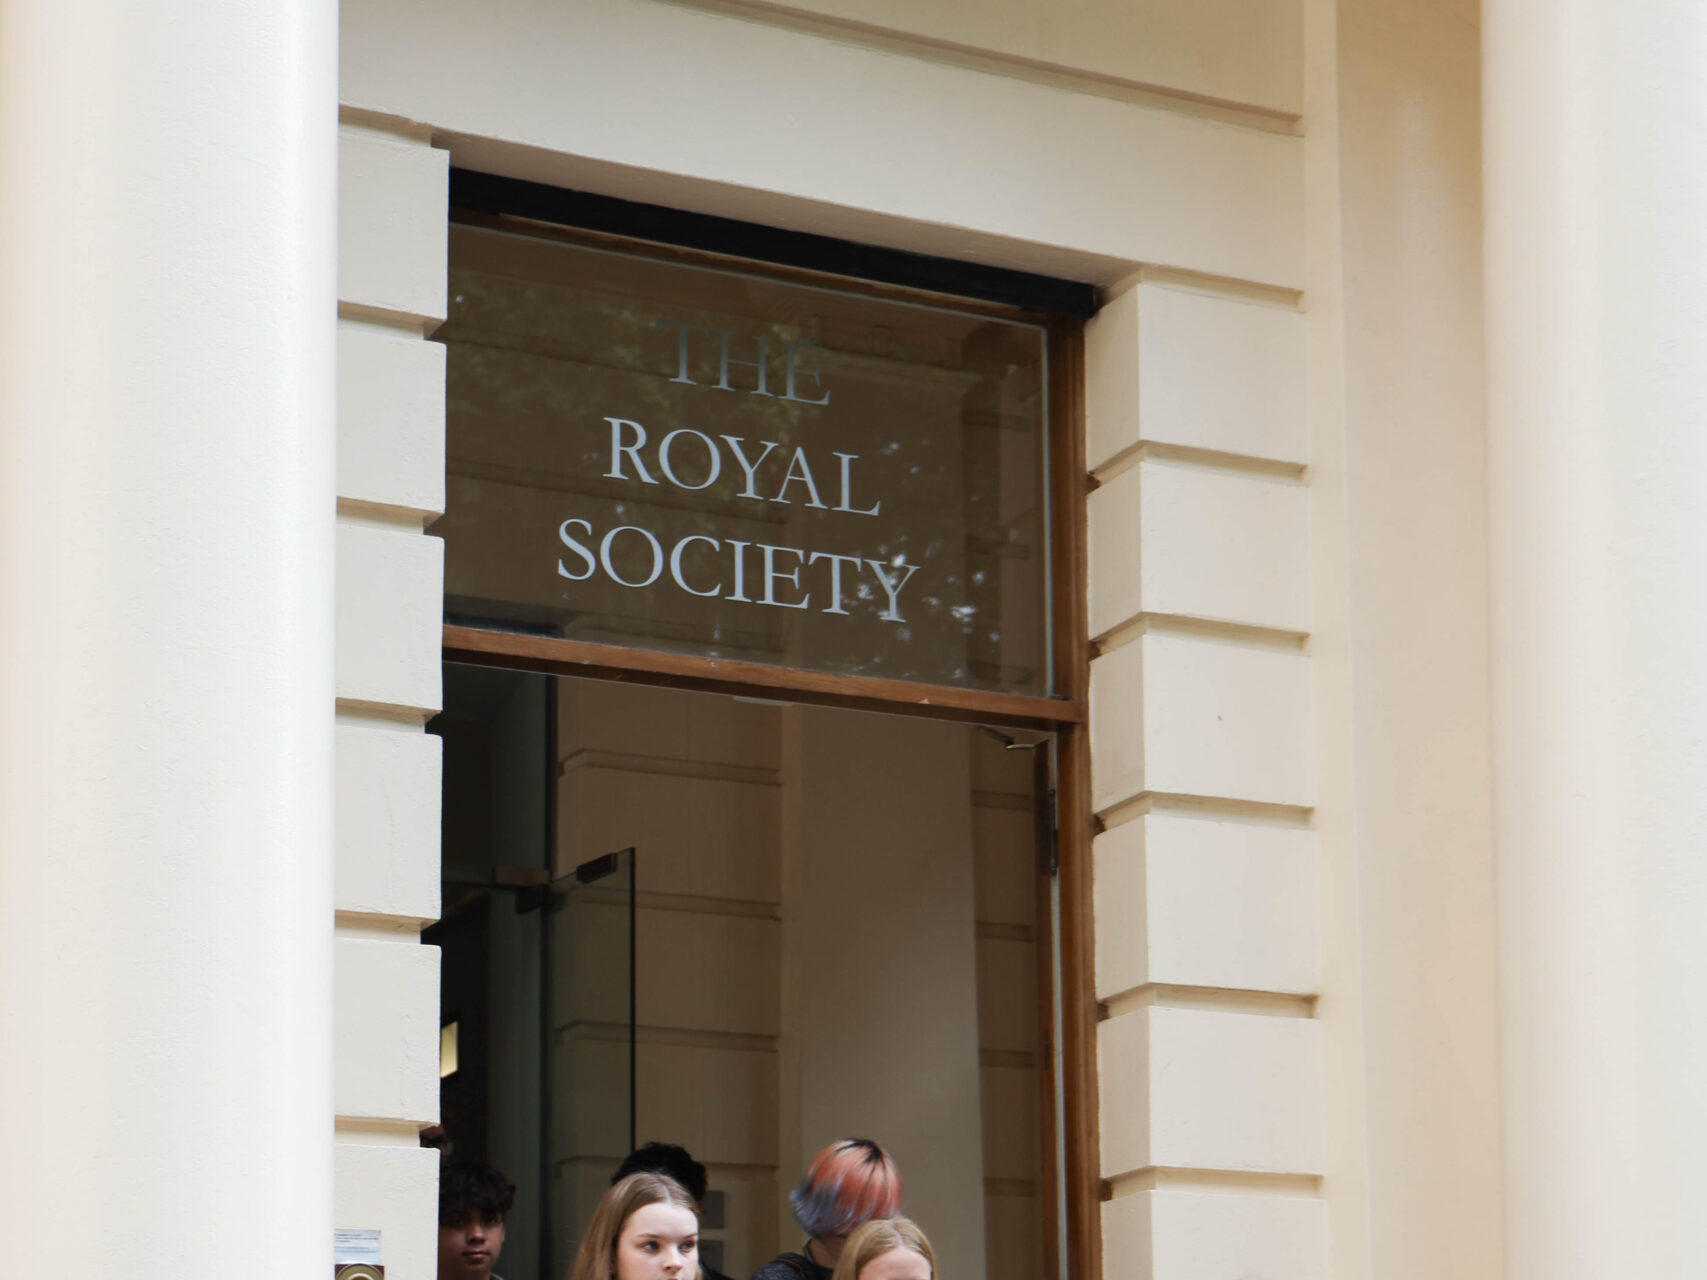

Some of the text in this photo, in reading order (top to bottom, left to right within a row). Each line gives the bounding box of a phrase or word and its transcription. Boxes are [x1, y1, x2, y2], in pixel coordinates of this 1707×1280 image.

[655, 320, 831, 406] THE
[603, 416, 881, 516] ROYAL
[556, 518, 921, 623] SOCIETY
